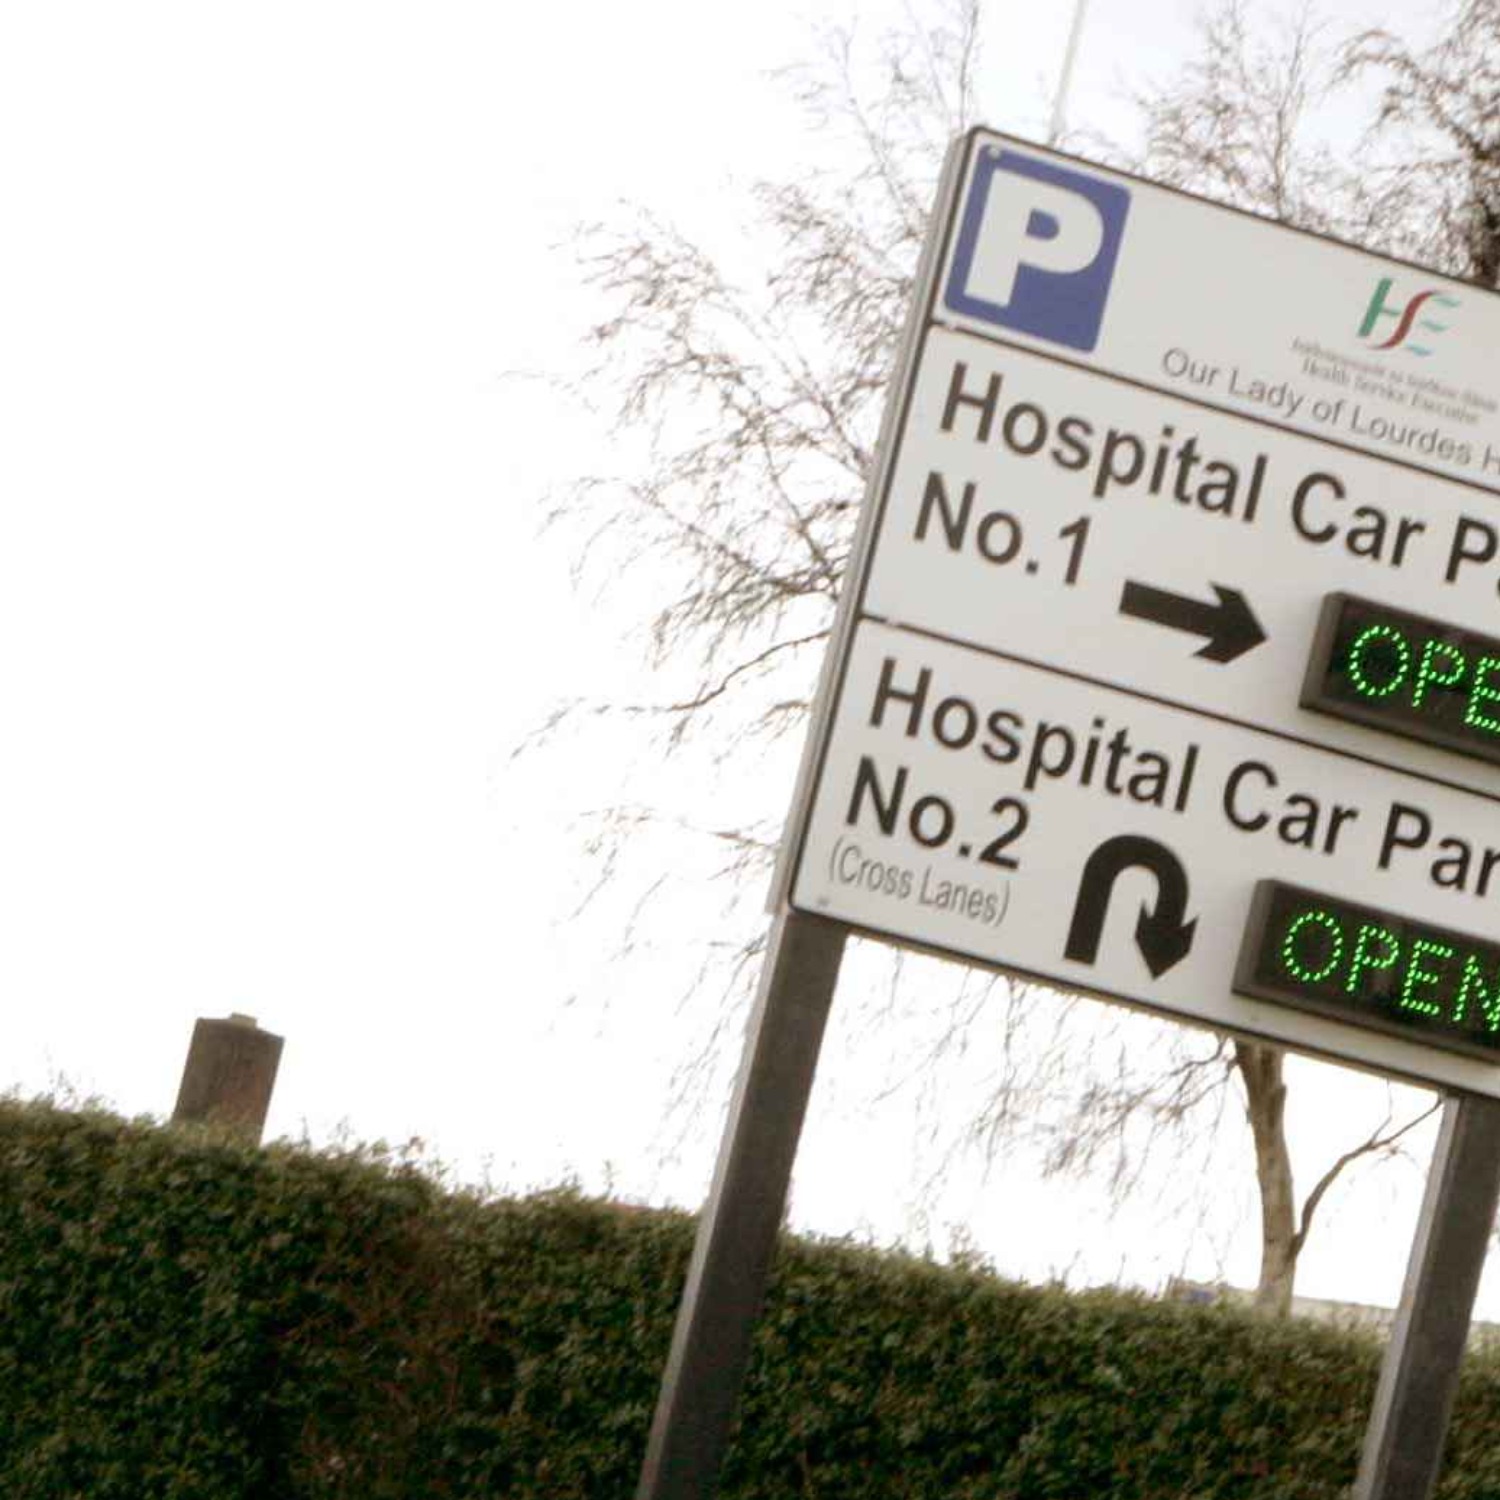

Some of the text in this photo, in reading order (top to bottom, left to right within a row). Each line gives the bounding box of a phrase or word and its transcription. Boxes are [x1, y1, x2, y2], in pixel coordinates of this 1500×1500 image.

[963, 168, 1104, 308] P
[1357, 277, 1462, 358] HSE
[939, 360, 1268, 524] Hospital
[1290, 472, 1425, 567] Car
[1162, 346, 1220, 386] Our
[1229, 369, 1303, 420] Lady
[1311, 396, 1346, 426] of
[1350, 405, 1473, 466] Lourdes
[913, 470, 1092, 586] No.1
[845, 755, 1030, 871] No.2
[868, 656, 1200, 813] Hospital
[1222, 761, 1360, 855] Car
[828, 836, 1011, 928] (Cross Lanes)
